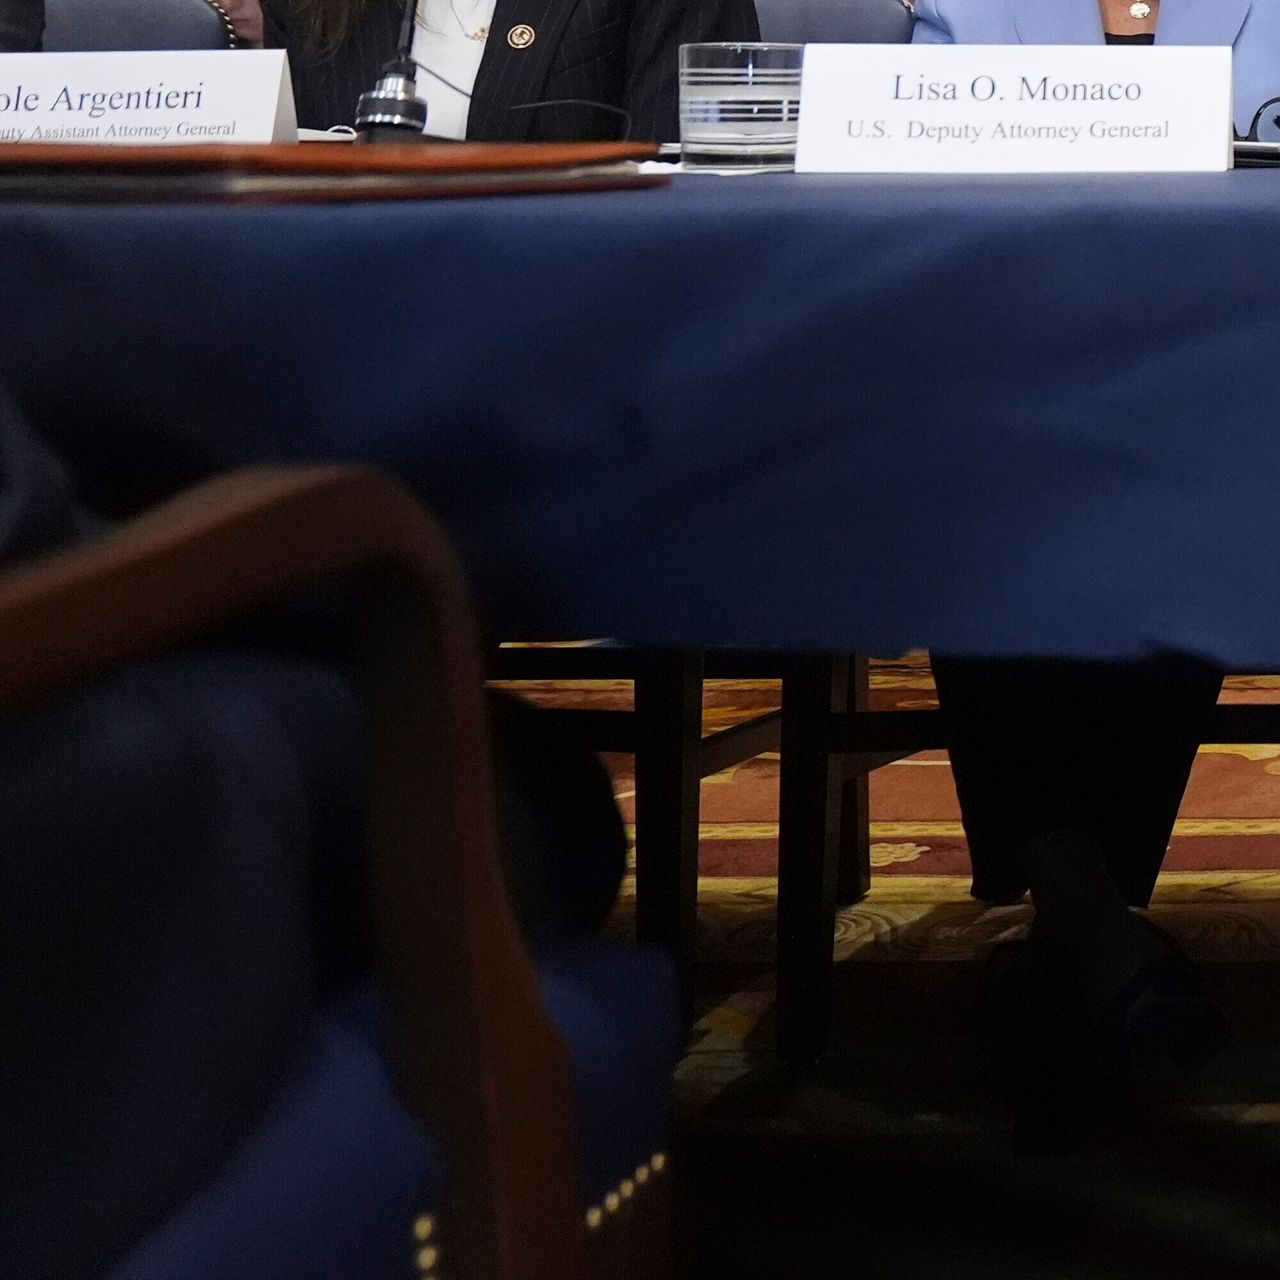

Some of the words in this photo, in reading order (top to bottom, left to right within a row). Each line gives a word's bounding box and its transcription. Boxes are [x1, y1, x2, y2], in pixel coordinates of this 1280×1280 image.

[49, 82, 204, 119] Argentieri
[893, 74, 959, 101] Lisa
[970, 75, 1005, 102] O.
[1018, 76, 1142, 102] Monaco
[30, 124, 100, 139] Assistant
[105, 122, 171, 140] Attorney
[176, 120, 237, 136] General
[848, 120, 892, 138] U.S.
[907, 120, 984, 144] Deputy
[990, 121, 1083, 143] Attorney
[1089, 121, 1169, 139] General
